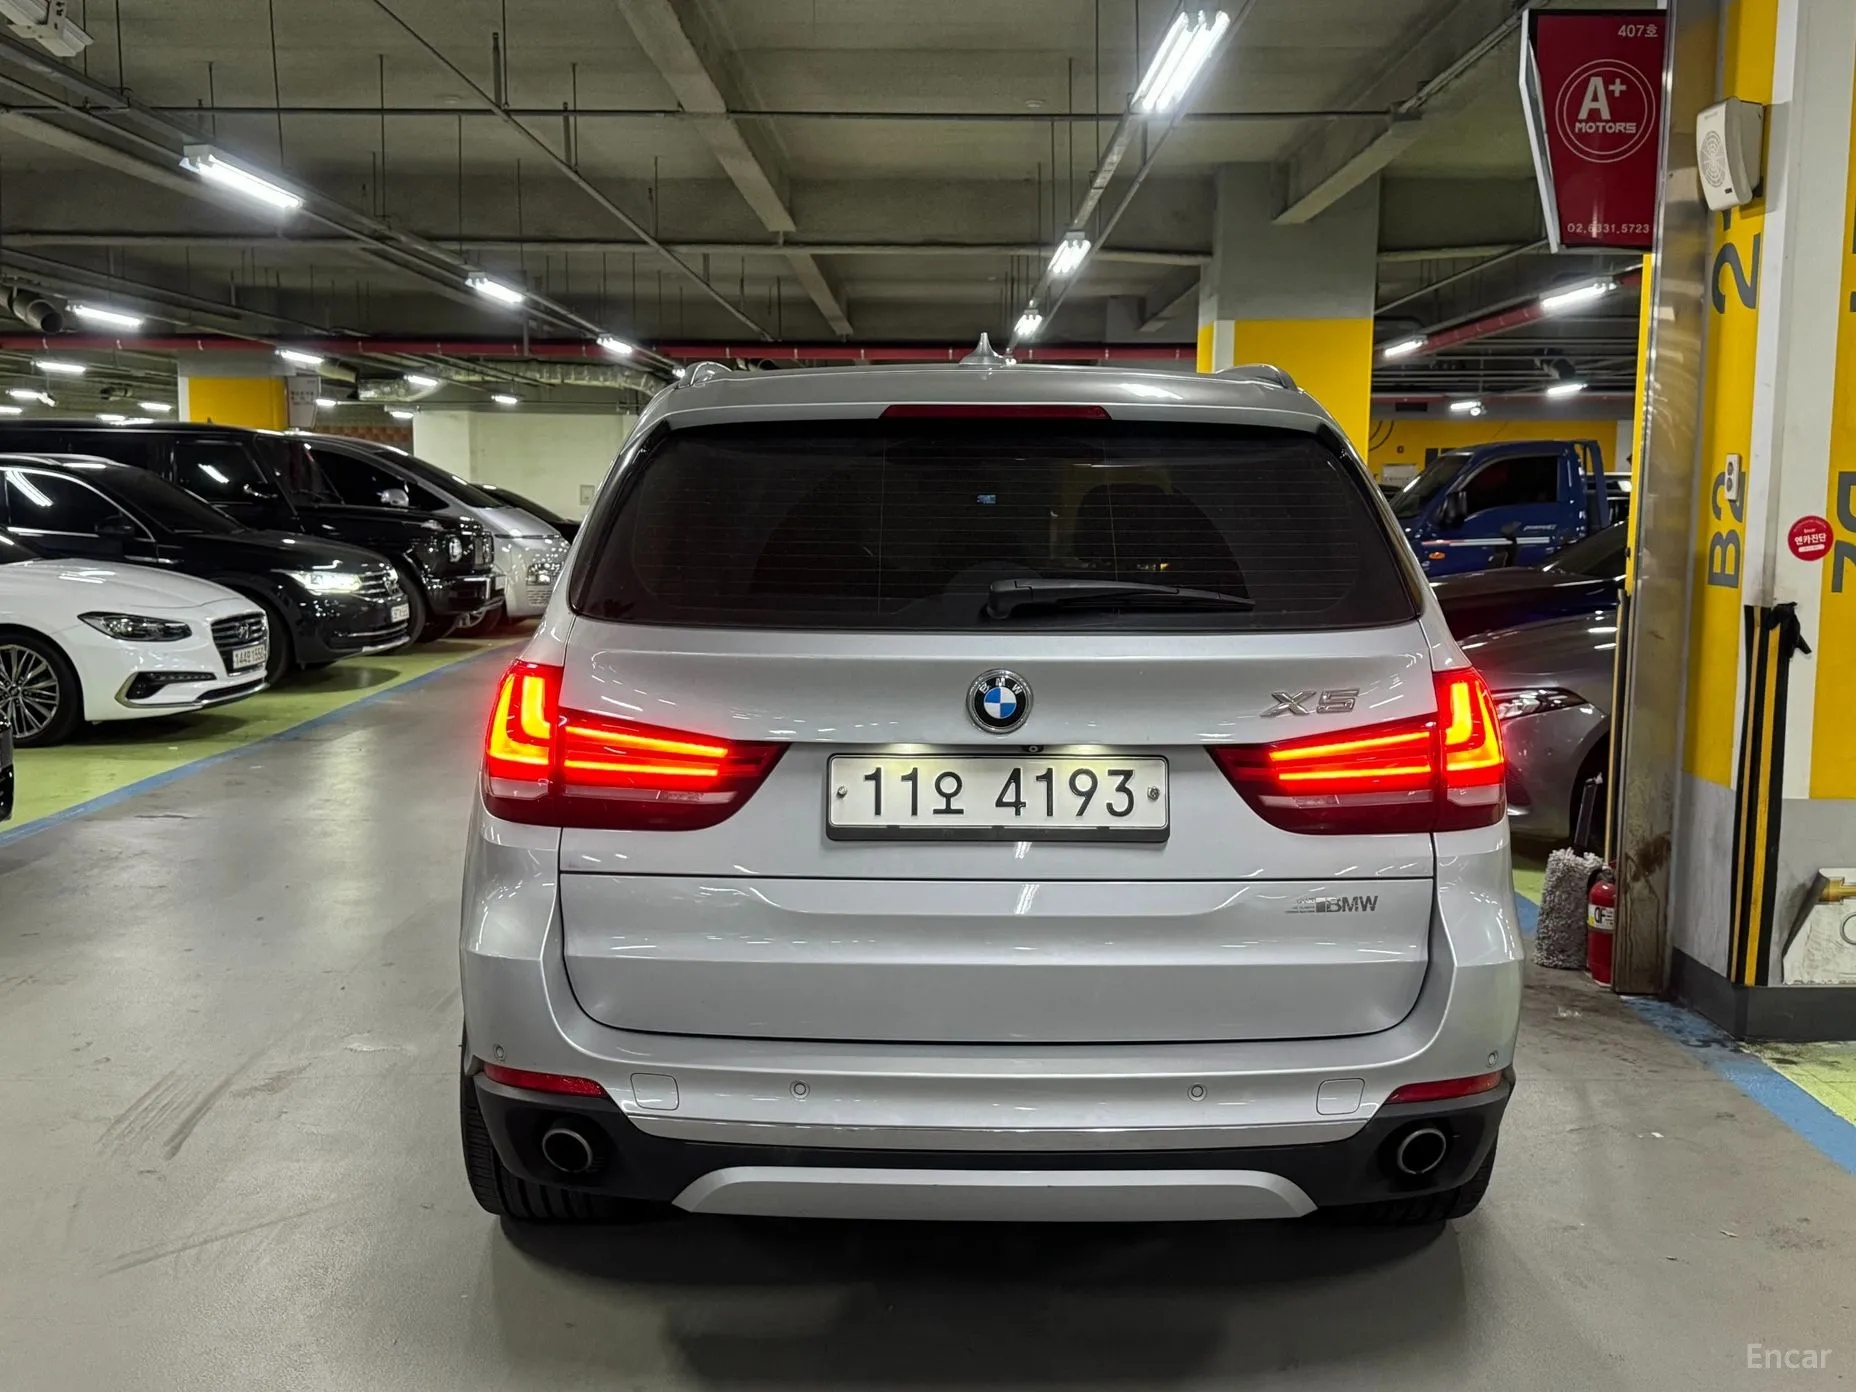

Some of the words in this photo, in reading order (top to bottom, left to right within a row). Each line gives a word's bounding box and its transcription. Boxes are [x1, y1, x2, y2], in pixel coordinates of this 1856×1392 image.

[1617, 24, 1658, 38] 407호
[1575, 121, 1637, 134] MOTORS
[1708, 471, 1746, 589] B2
[1794, 532, 1827, 546] 엔카진단
[979, 677, 1023, 695] BMW
[1259, 688, 1360, 718] X5
[863, 766, 965, 817] 11오
[994, 767, 1135, 818] 4193
